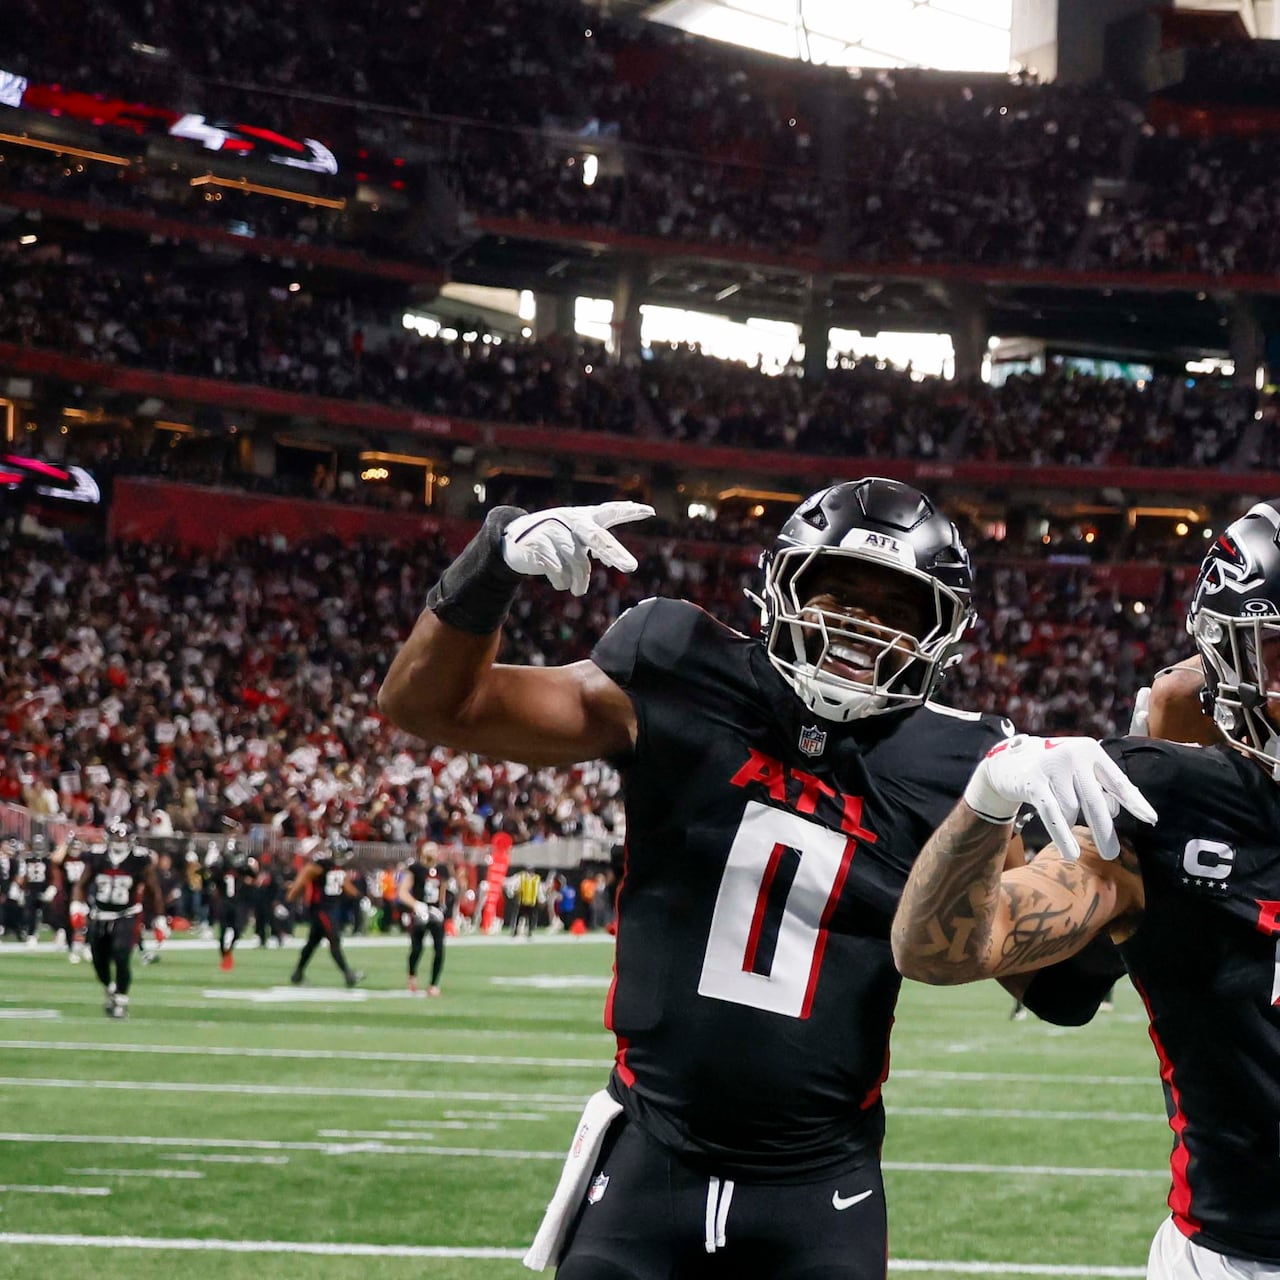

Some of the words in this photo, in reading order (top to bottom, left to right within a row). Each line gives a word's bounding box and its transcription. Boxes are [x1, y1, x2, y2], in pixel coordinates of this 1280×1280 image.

[864, 533, 901, 552] ATL
[730, 748, 877, 844] ATL
[1182, 838, 1237, 880] C
[699, 800, 857, 1019] 0
